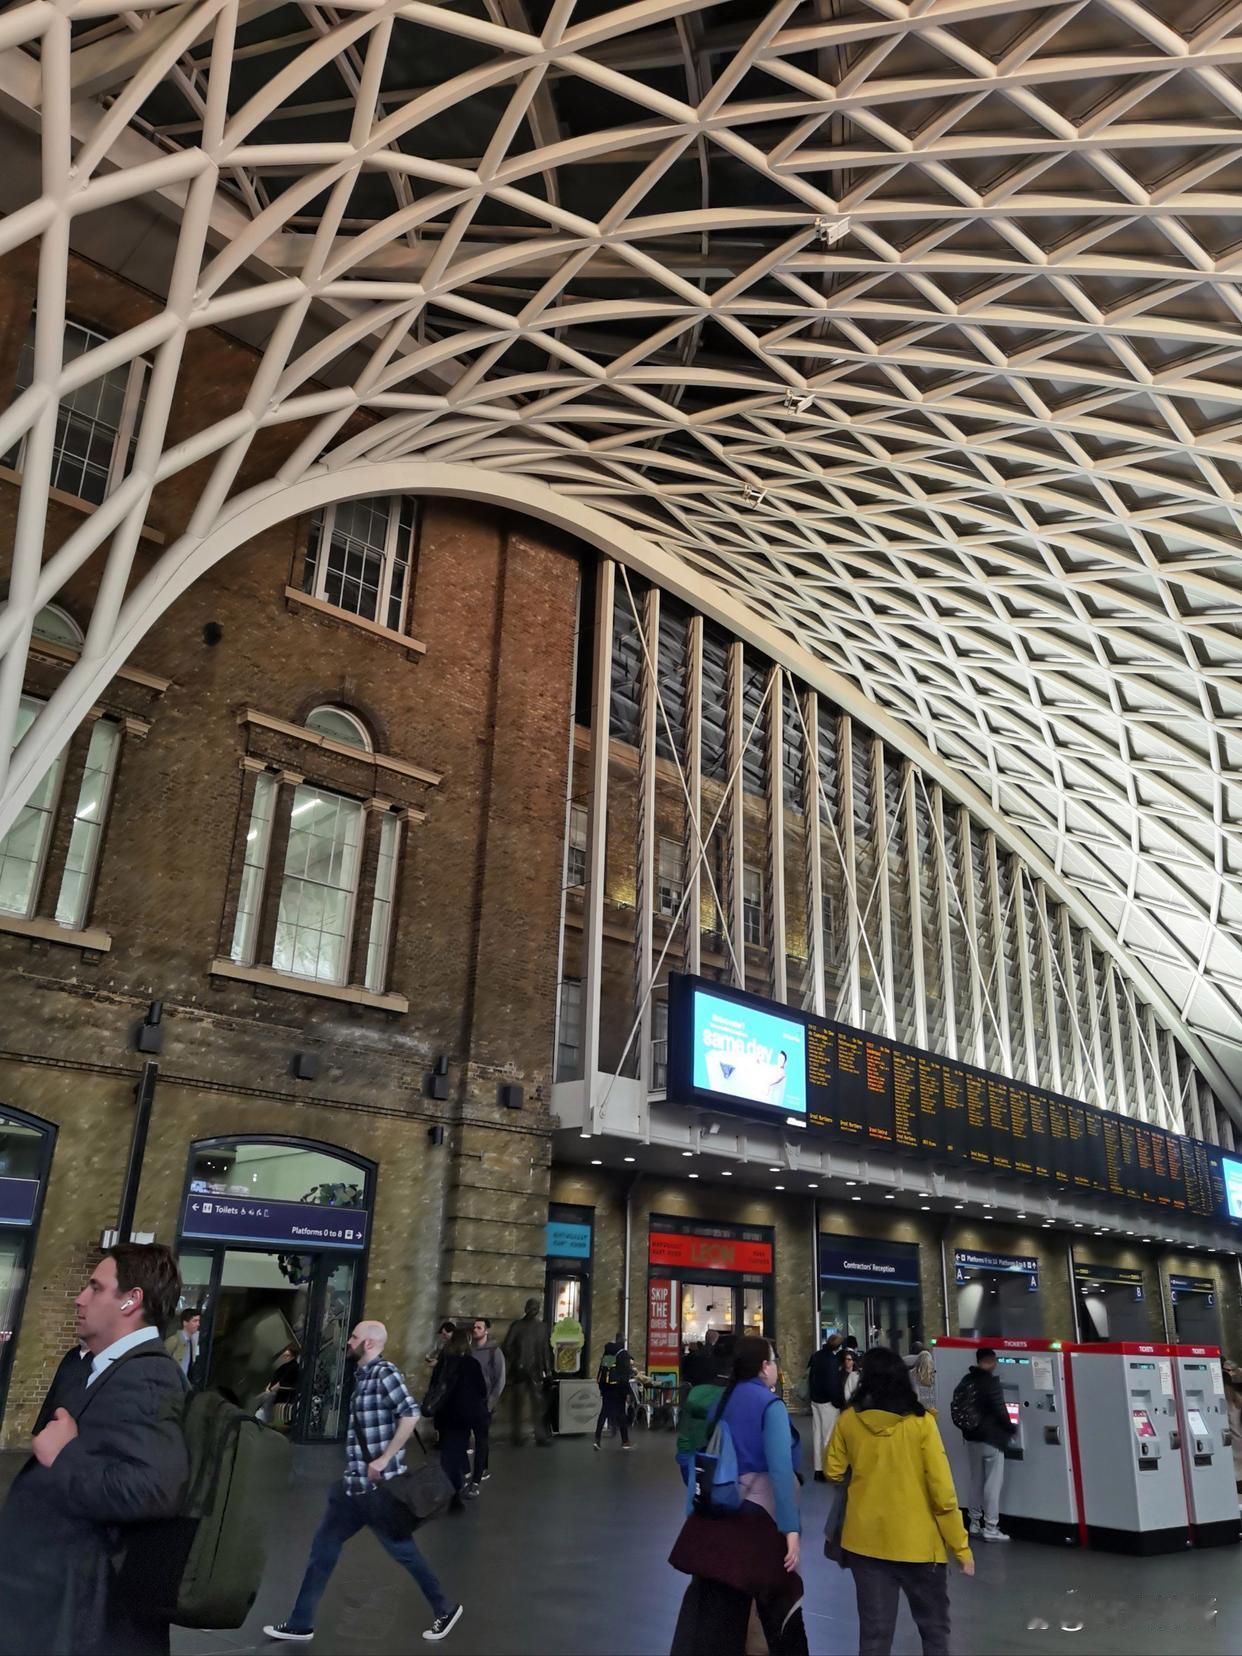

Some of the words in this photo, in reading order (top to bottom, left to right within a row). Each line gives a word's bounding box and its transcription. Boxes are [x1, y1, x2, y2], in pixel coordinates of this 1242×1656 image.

[215, 1205, 239, 1215] Toilets
[291, 1226, 323, 1237] Platforms
[690, 1240, 735, 1264] LEON
[966, 1255, 984, 1263] Platforms
[872, 1263, 896, 1274] Reception
[956, 1268, 963, 1280] A
[1030, 1275, 1037, 1287] A
[651, 1287, 668, 1301] SKIP
[1136, 1287, 1142, 1297] B
[1171, 1290, 1176, 1301] C
[1207, 1294, 1213, 1305] C
[651, 1302, 668, 1318] THE
[650, 1318, 668, 1329] QUEUE
[1003, 1340, 1028, 1348] TICKETS
